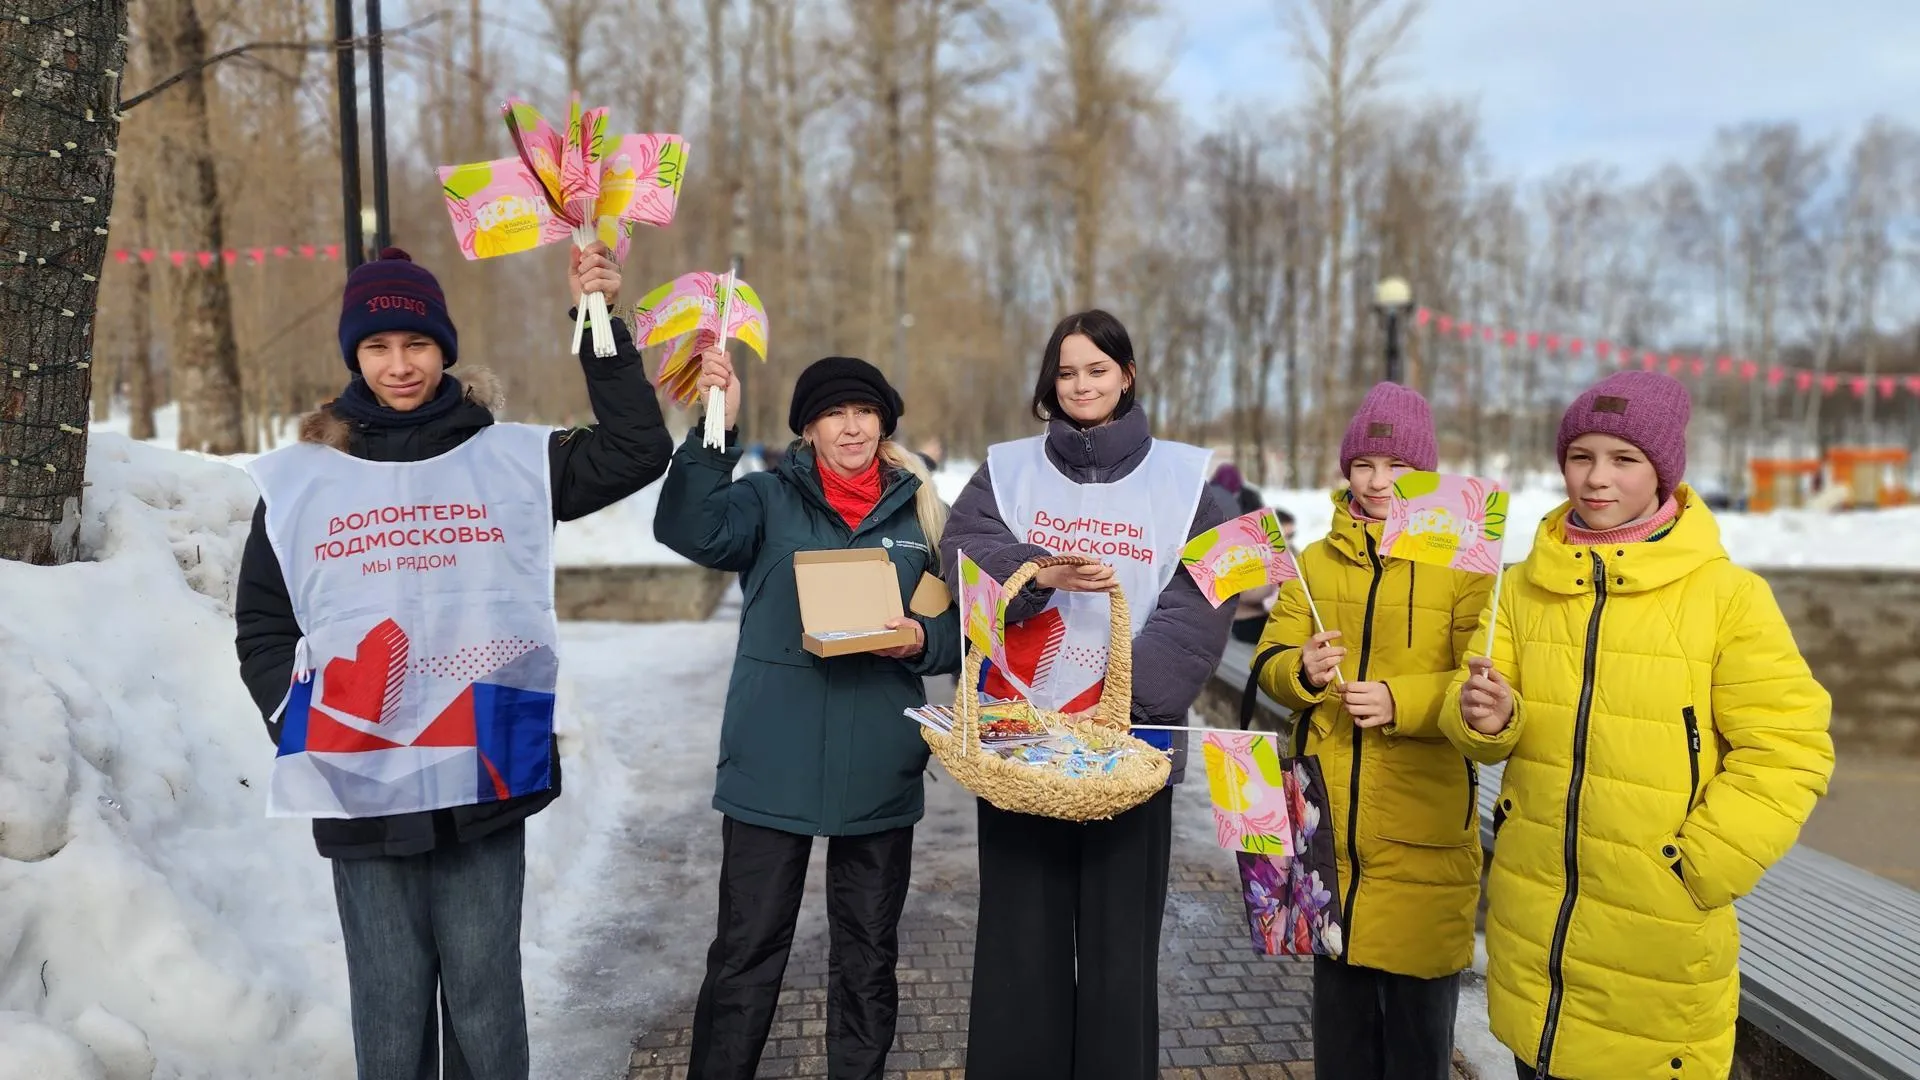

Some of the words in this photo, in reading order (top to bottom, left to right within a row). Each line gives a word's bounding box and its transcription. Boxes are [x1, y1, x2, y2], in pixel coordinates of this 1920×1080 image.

[366, 295, 426, 317] YOUNG
[328, 503, 487, 536] ВОЛОНТЕРЫ
[314, 526, 505, 563] ПОДМОСКОВЬЯ
[362, 557, 391, 576] МЫ
[396, 553, 457, 573] РЯДОМ
